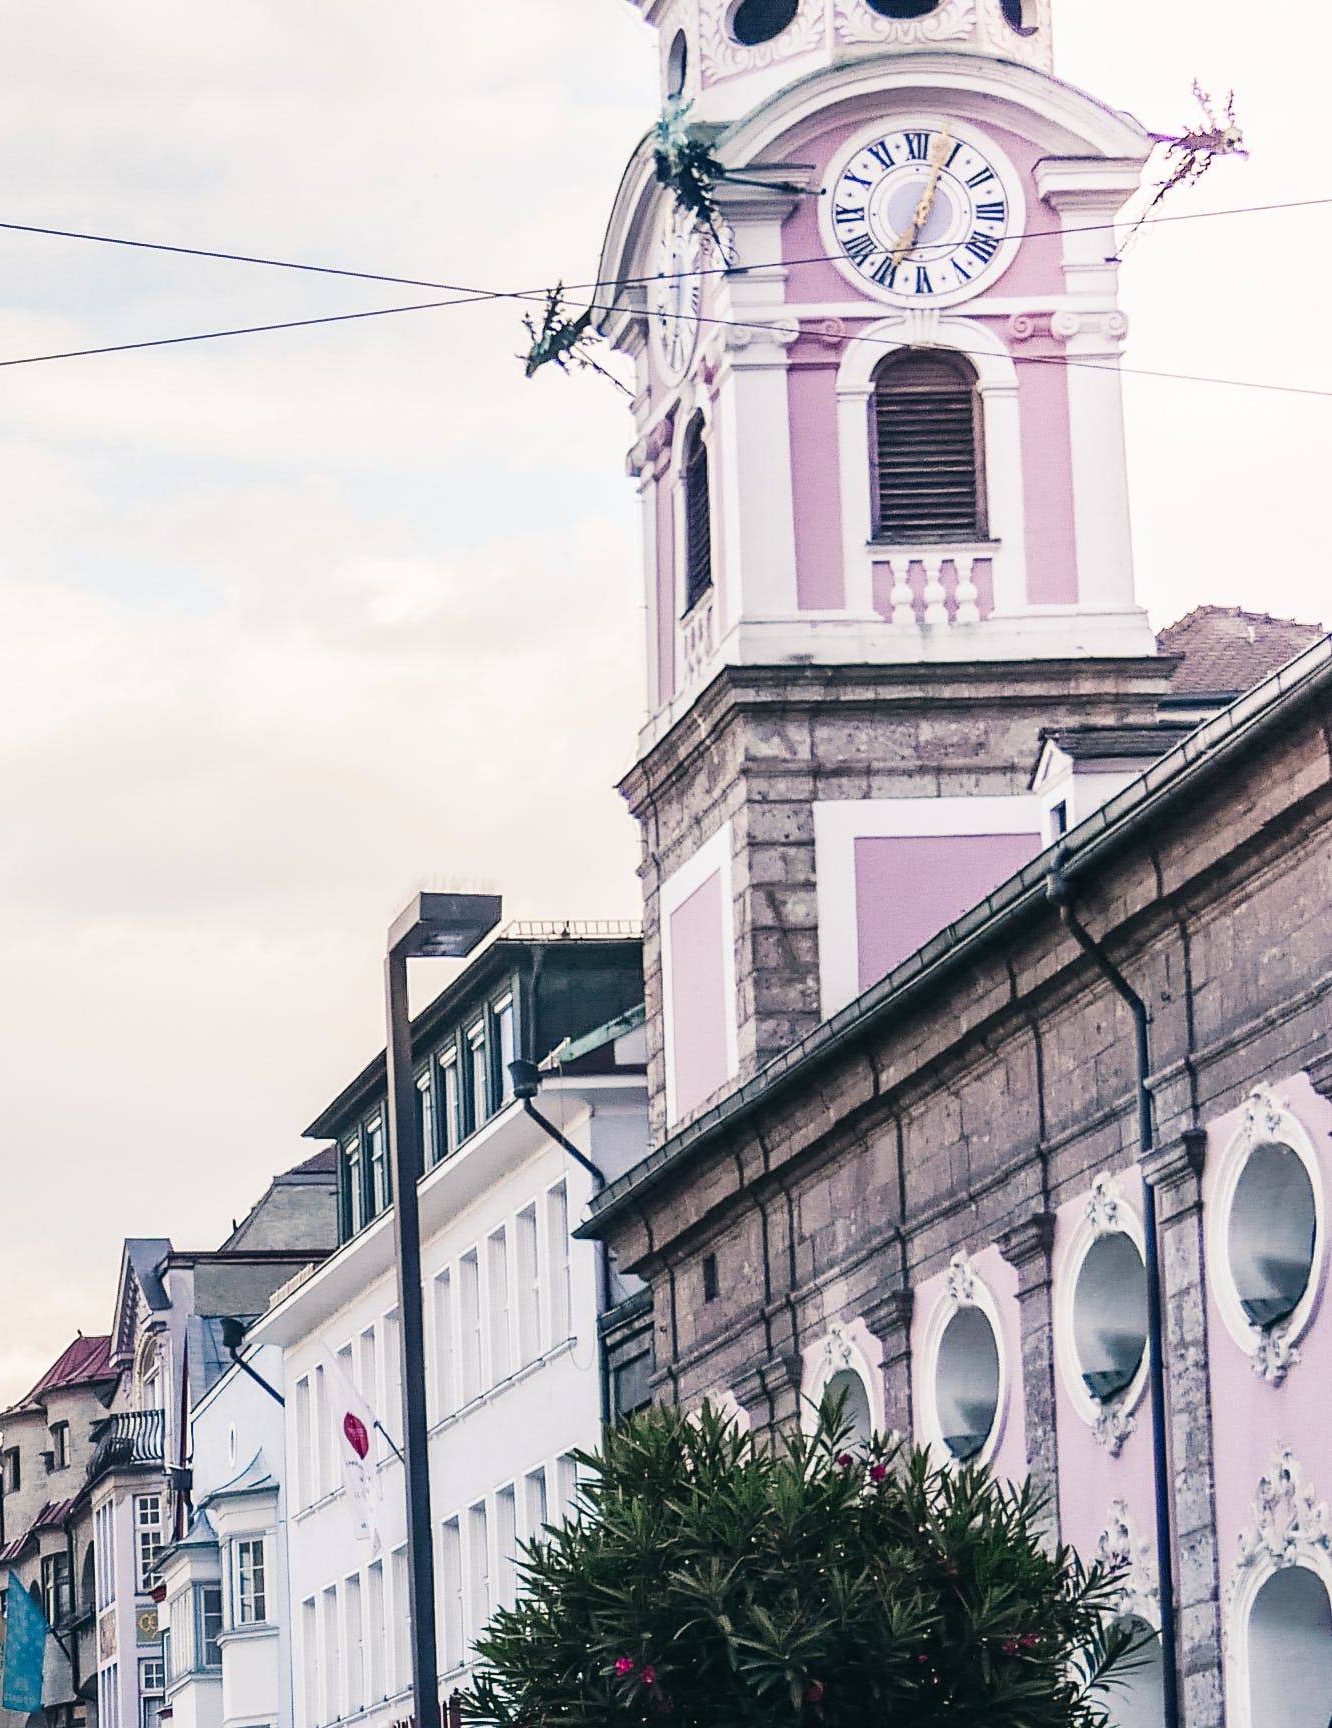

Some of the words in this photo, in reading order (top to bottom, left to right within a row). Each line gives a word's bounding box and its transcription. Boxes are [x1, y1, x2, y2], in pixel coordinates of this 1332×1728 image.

[868, 140, 896, 172] XI
[904, 132, 929, 161] XII
[945, 143, 963, 168] I
[844, 169, 872, 191] X
[965, 167, 995, 189] II
[836, 203, 865, 224] IX
[976, 201, 1005, 222] III
[915, 266, 933, 294] VI
[951, 258, 971, 284] V
